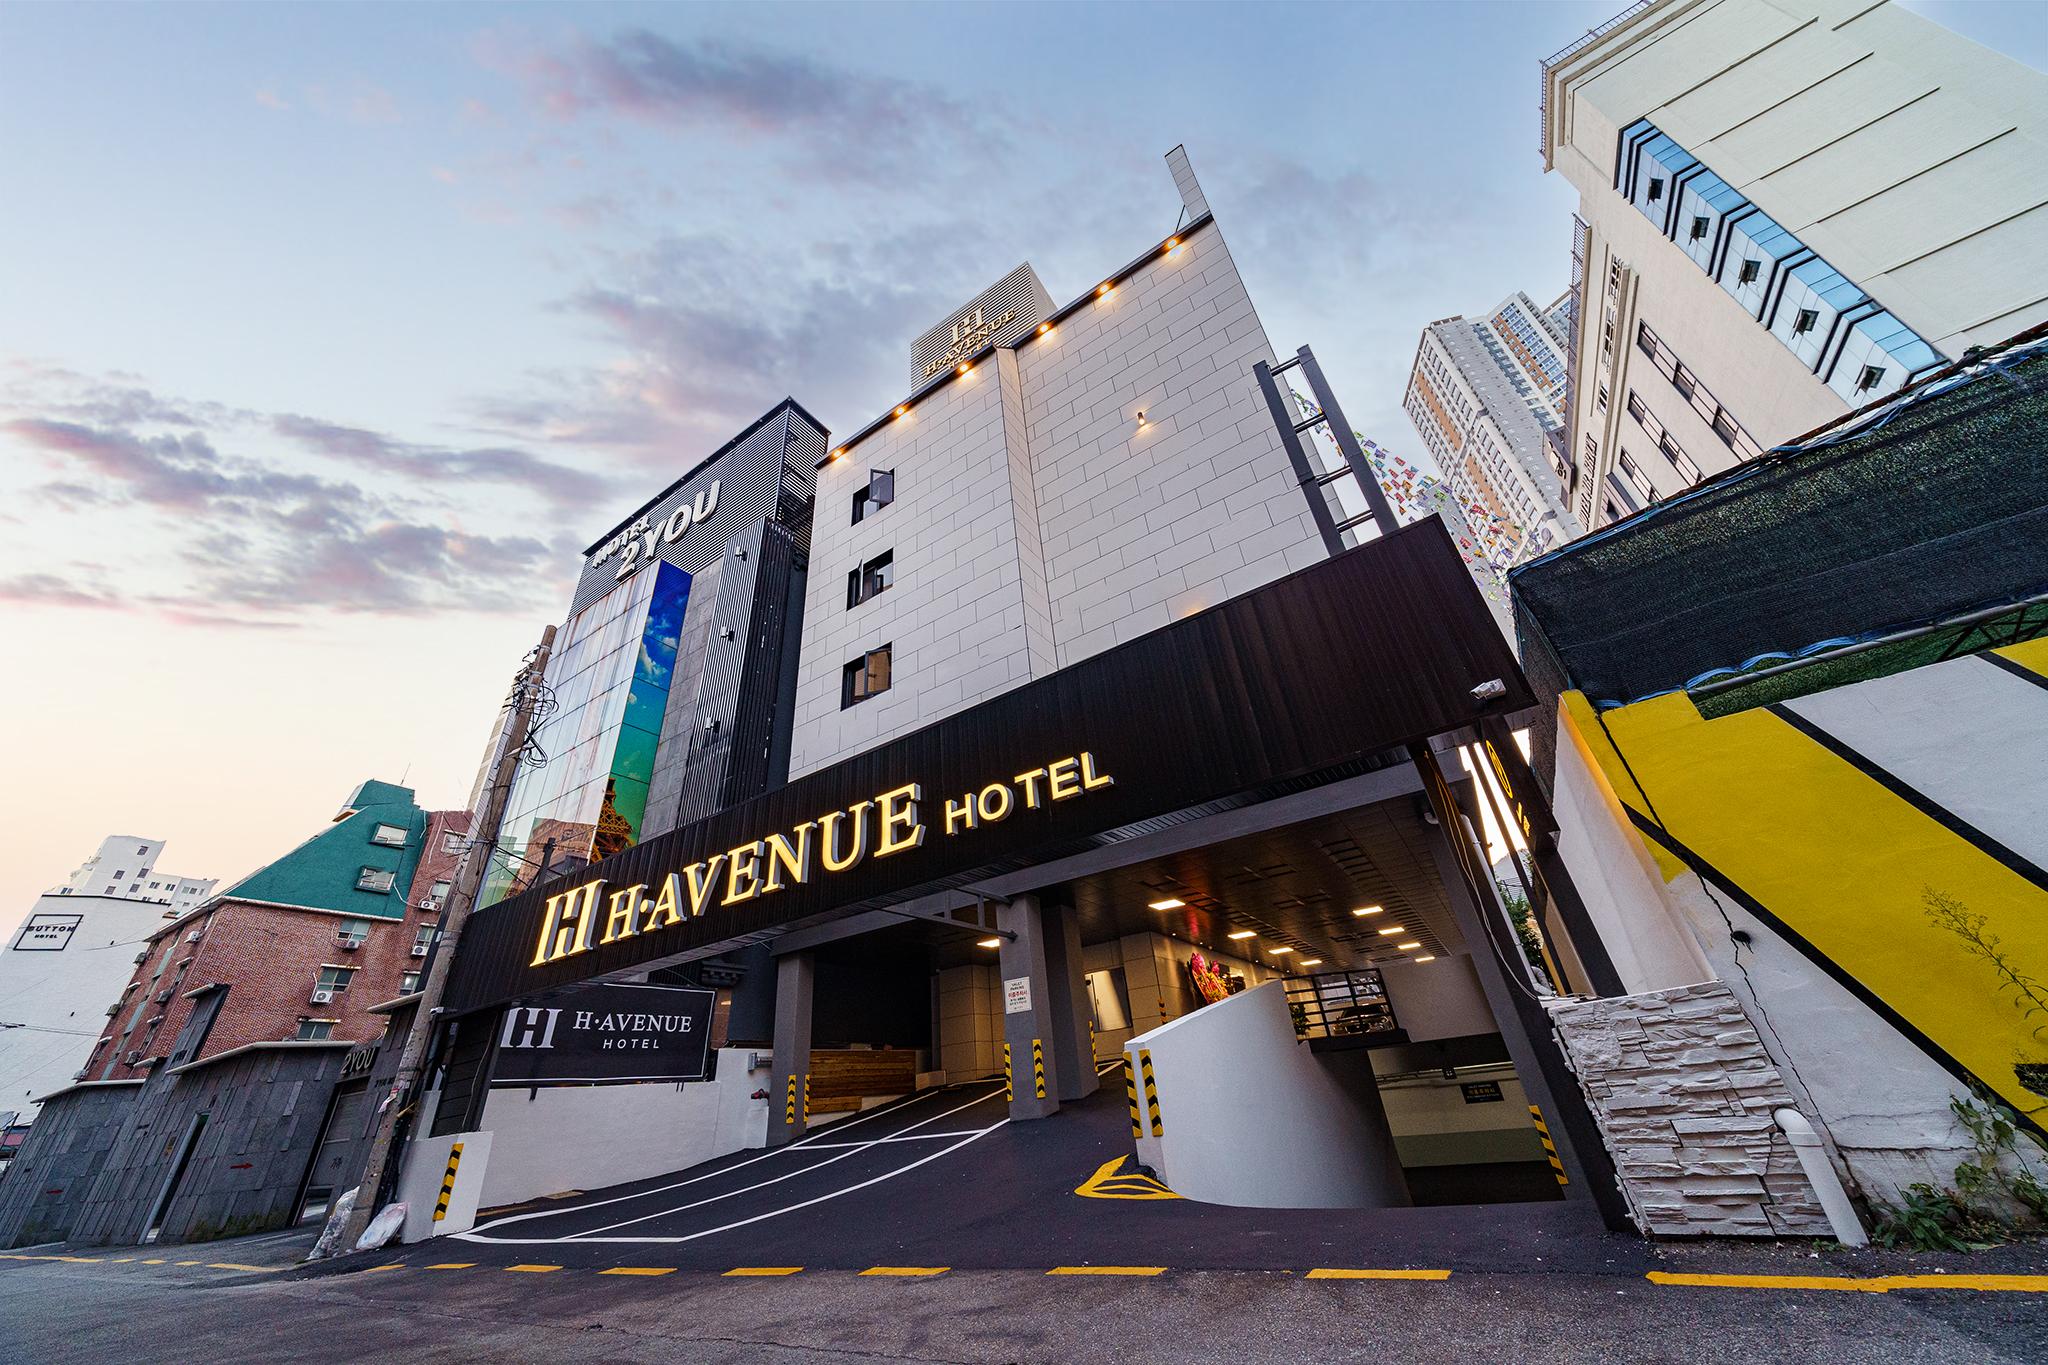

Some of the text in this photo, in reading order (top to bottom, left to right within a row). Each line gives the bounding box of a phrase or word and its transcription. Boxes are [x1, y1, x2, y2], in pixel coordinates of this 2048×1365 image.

[615, 479, 721, 582] 2YOU
[945, 751, 1115, 836] HOTEL
[340, 1047, 377, 1075] 2YOU
[603, 1038, 660, 1049] HOTEL
